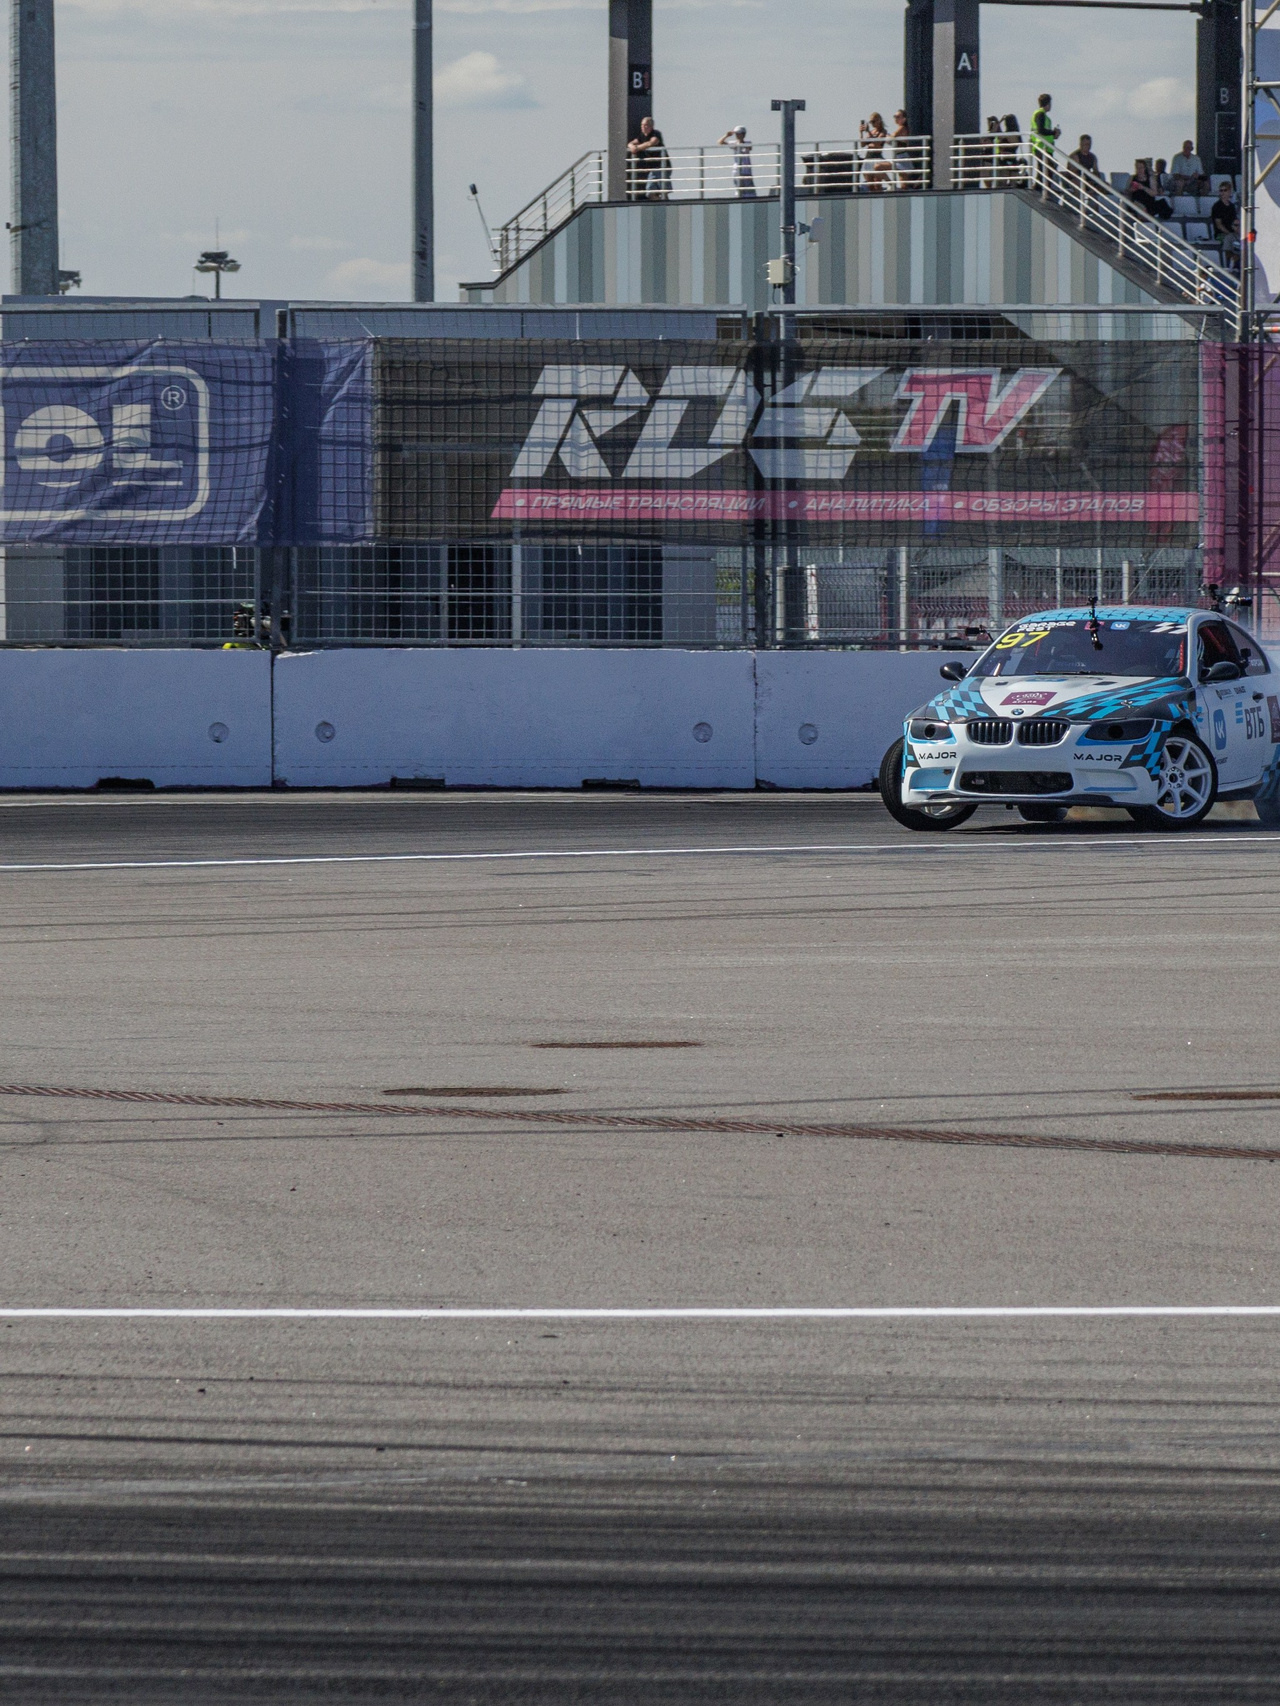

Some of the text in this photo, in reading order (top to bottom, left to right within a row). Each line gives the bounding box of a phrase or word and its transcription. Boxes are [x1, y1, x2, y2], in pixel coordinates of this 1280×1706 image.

[889, 367, 1065, 453] TV
[0, 404, 183, 487] OL
[531, 497, 767, 513] ПРЯМЫЕ ТРАНСЛЯЦИИ
[803, 498, 931, 512] АНАЛИТИКА
[970, 499, 1146, 513] ОБЗОРЫ ЭТАПОВ
[995, 631, 1050, 650] 97
[1244, 706, 1265, 740] ВТБ
[918, 751, 957, 760] MAJOR
[1073, 752, 1123, 763] MAJOR
